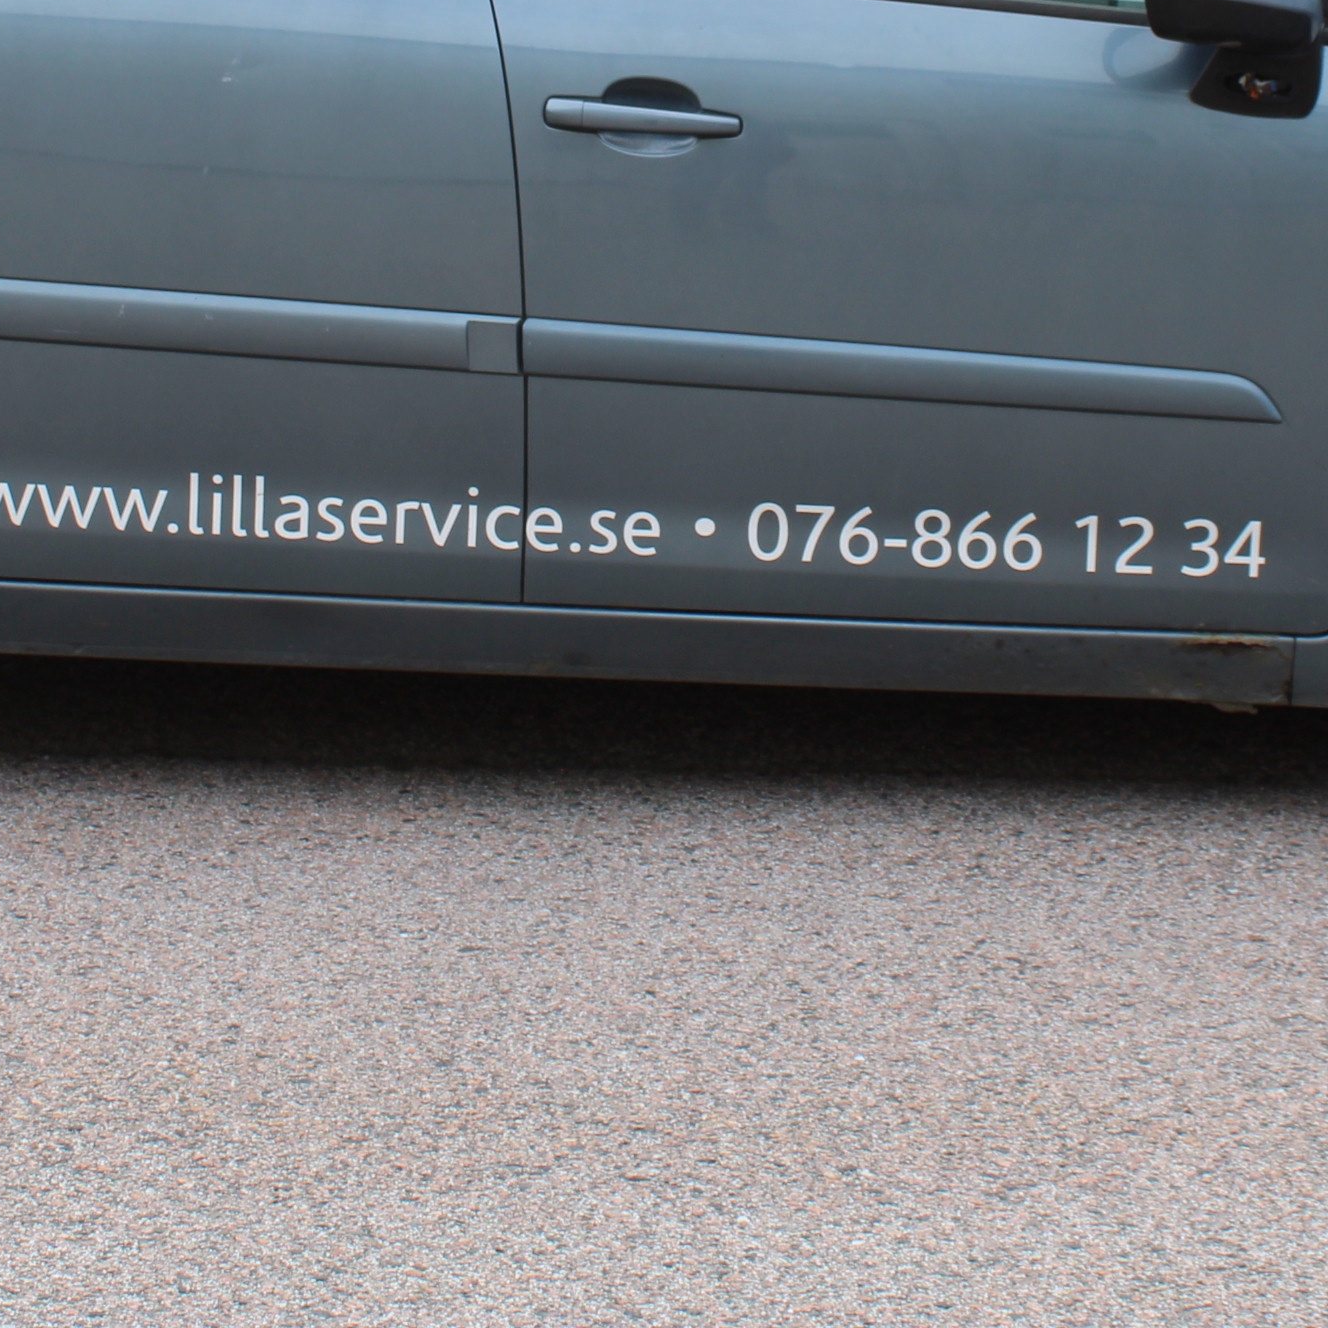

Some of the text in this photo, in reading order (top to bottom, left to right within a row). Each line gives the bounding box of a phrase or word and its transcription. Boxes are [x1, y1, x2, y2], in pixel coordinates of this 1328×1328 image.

[747, 502, 1043, 572] 076-866
[1075, 514, 1155, 575] 12
[1180, 518, 1266, 578] 34
